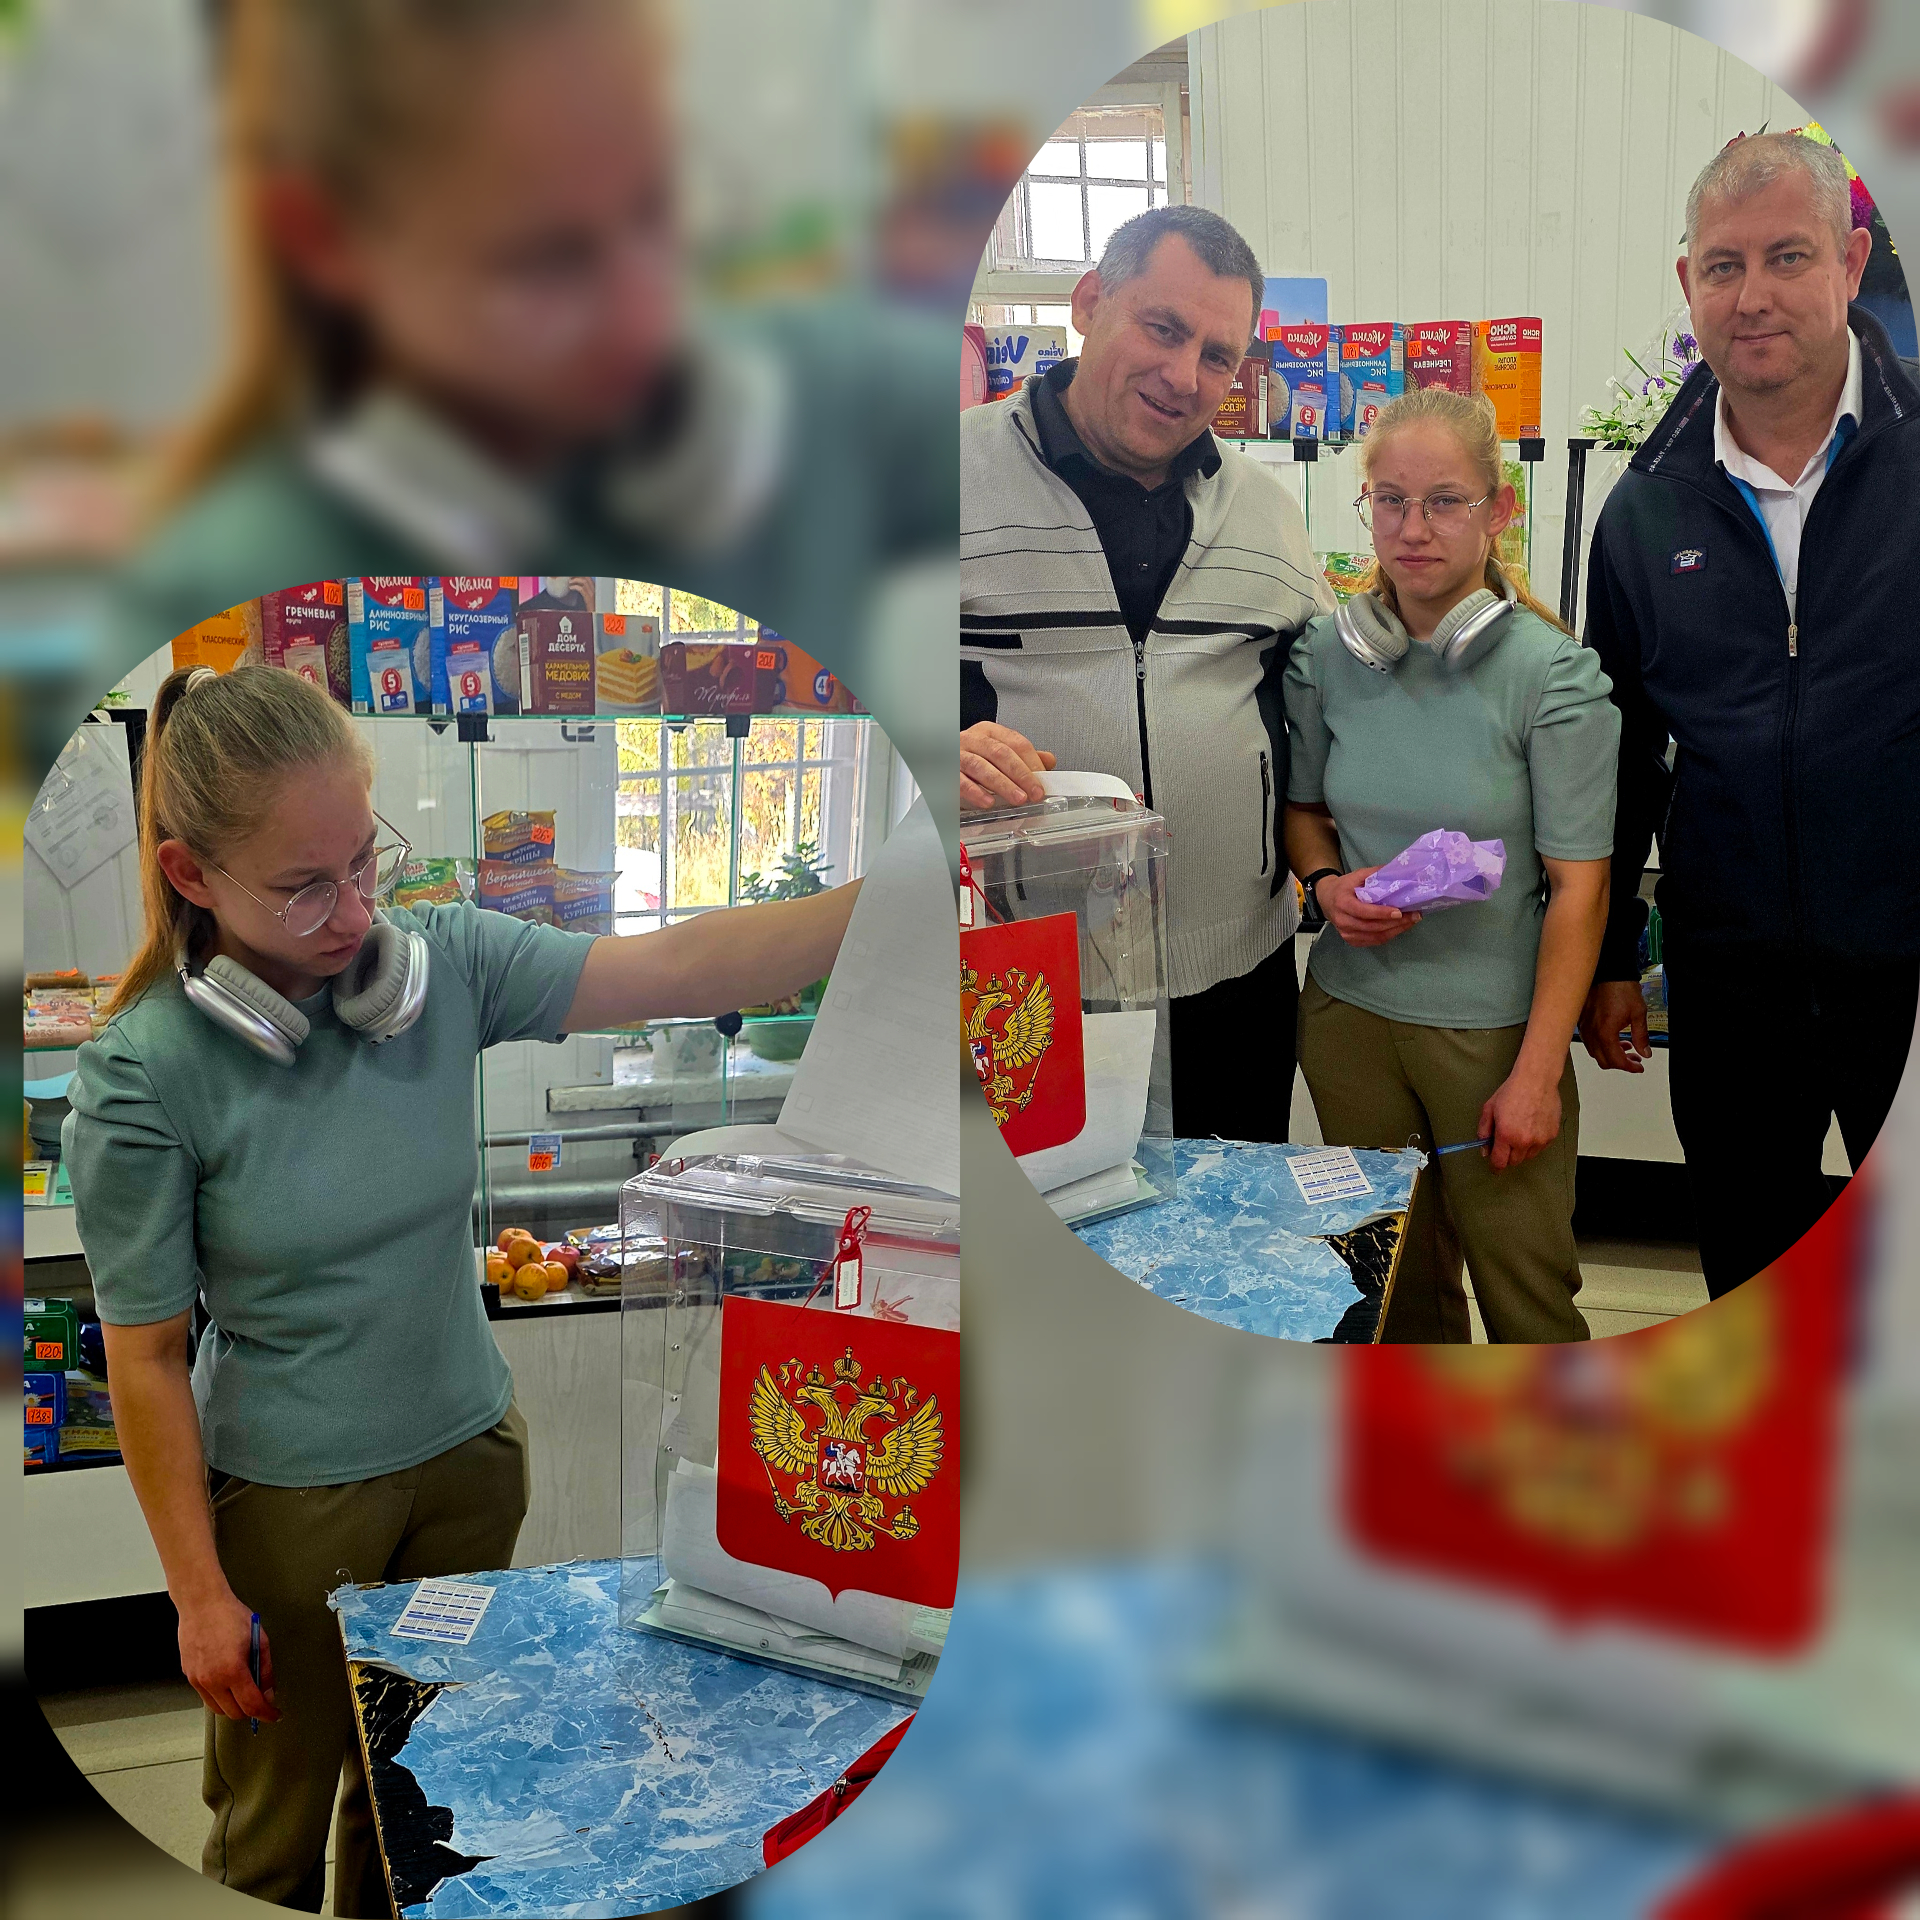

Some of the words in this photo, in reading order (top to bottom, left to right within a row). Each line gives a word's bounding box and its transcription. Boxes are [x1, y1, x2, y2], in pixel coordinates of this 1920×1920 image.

[285, 605, 336, 620] ГРЕЧНЕВАЯ
[448, 612, 509, 625] КРУГЛОЗЕРНЫЙ
[370, 619, 390, 632] РИС
[448, 623, 470, 635] РИС
[201, 634, 245, 647] КЛАССИЧЕСКИЕ
[556, 634, 577, 643] ДОМ
[547, 643, 585, 653] ДЕСЕРТА
[386, 673, 396, 689] 5
[545, 671, 590, 682] МЕДОВИК
[465, 677, 476, 692] 5
[563, 904, 602, 920] КУРИЦЫ
